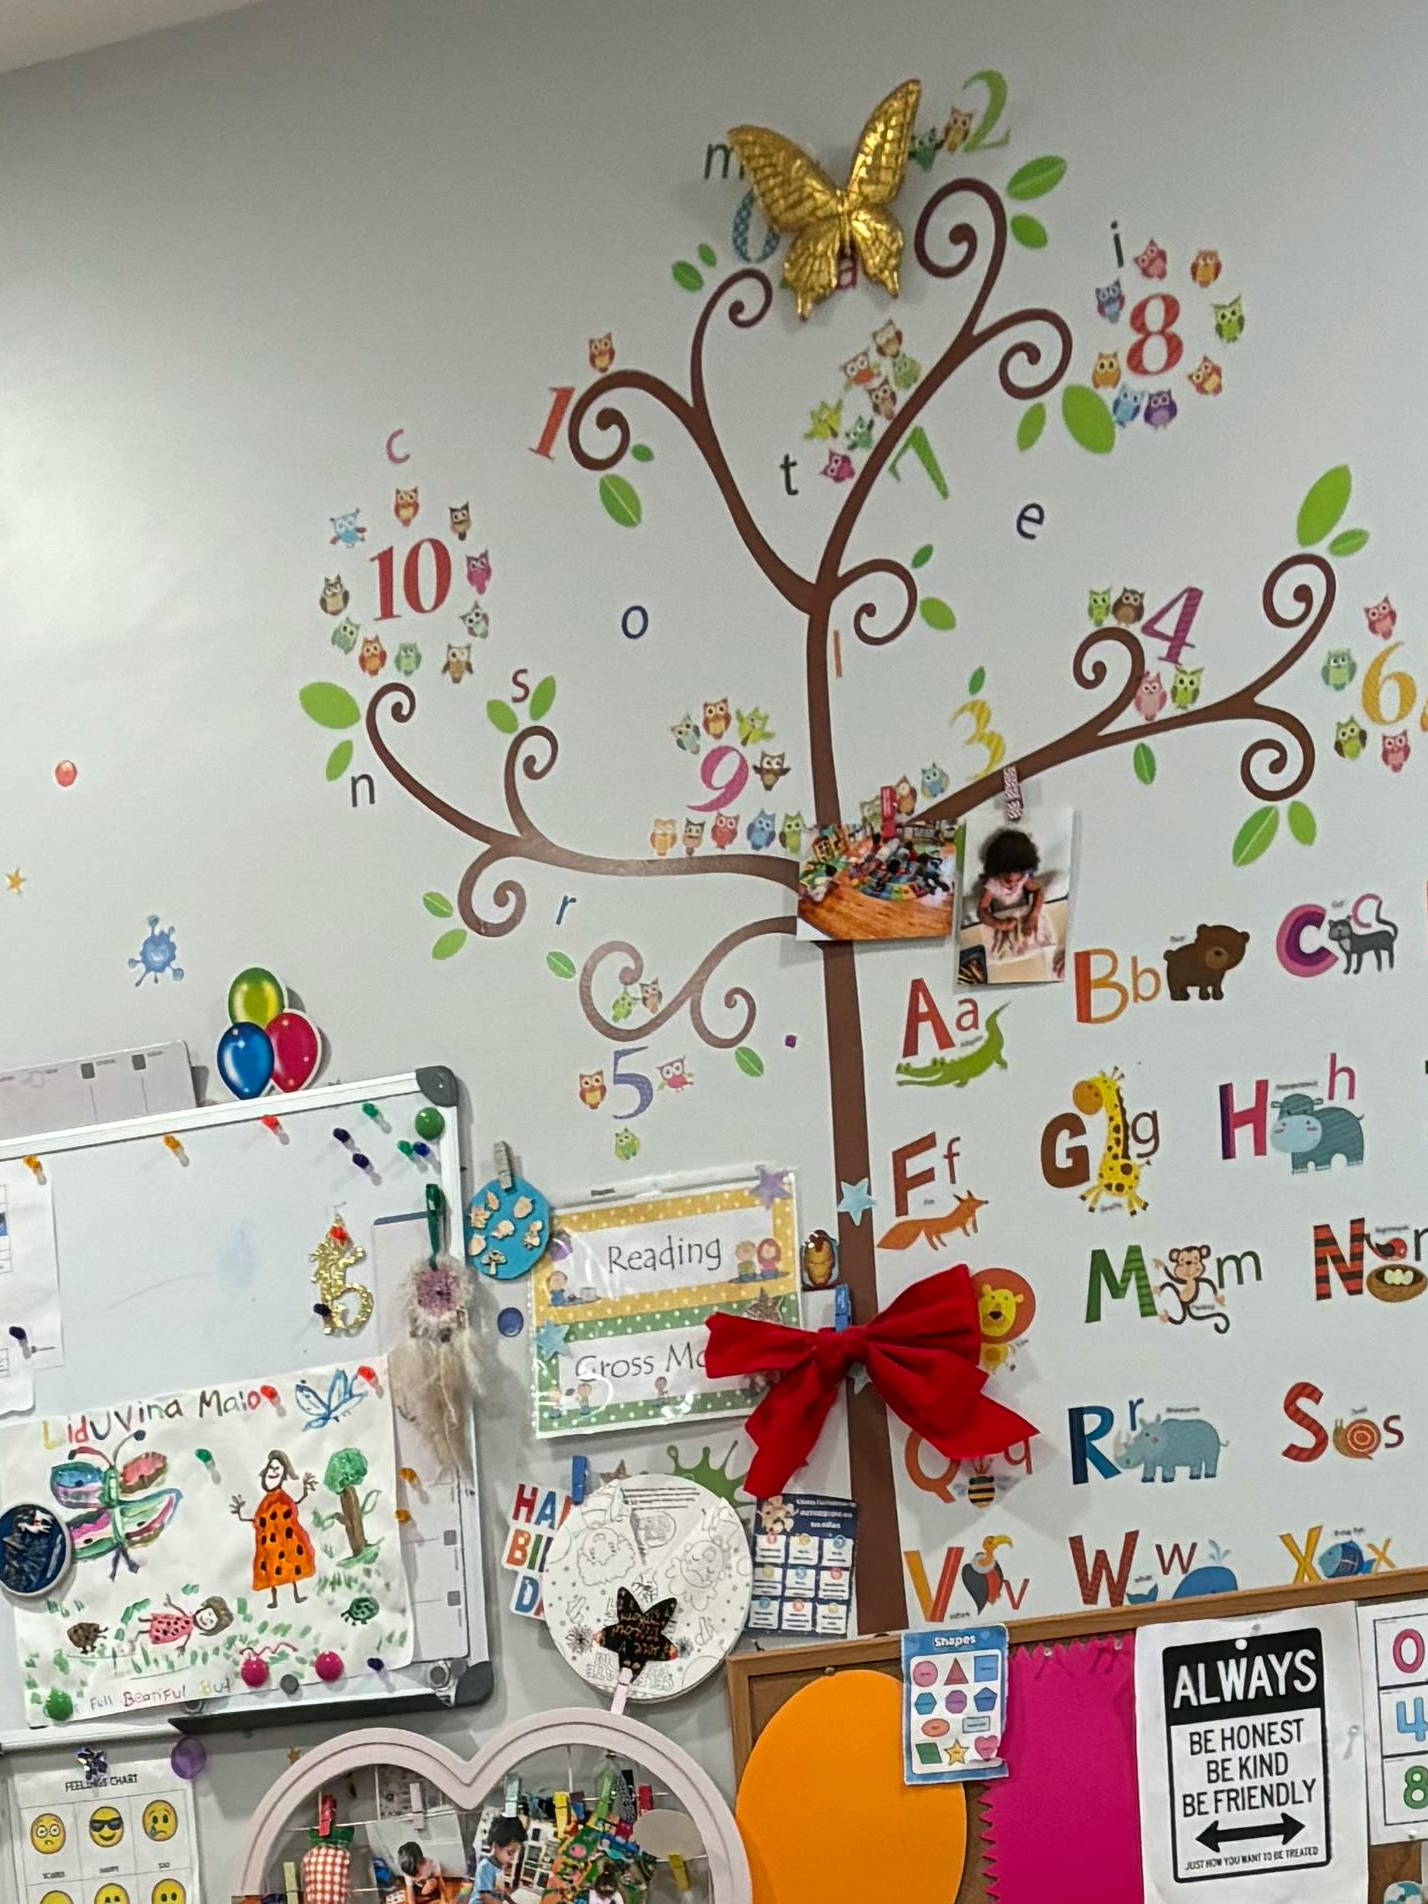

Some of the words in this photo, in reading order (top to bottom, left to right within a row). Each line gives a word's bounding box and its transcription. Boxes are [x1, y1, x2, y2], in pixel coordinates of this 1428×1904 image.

[961, 69, 1011, 153] 2
[1126, 293, 1184, 376] 8
[780, 453, 798, 496] t
[1016, 502, 1045, 541] e
[369, 537, 452, 622] 10
[1140, 585, 1205, 666] 4
[1361, 640, 1417, 726] 6
[687, 745, 749, 813] 9
[612, 1046, 654, 1121] 5
[1219, 1079, 1269, 1160] H
[1040, 1112, 1090, 1189] G
[607, 1236, 722, 1275] Reading
[575, 1351, 655, 1382] Gross
[933, 1635, 976, 1648] Shapes
[1392, 1628, 1425, 1674] 0
[1173, 1648, 1318, 1709] ALWAYS
[1189, 1729, 1217, 1756] BE
[1221, 1718, 1304, 1752] HONEST
[1396, 1696, 1428, 1742] 4
[65, 1778, 108, 1792] FEELINGS
[109, 1773, 138, 1786] CHART
[1206, 1757, 1234, 1784] BE
[1239, 1751, 1289, 1780] KIND
[1182, 1791, 1209, 1818] BE
[1214, 1778, 1316, 1814] FRIENDLY
[1185, 1858, 1205, 1871] JUST
[1206, 1857, 1222, 1869] HOW
[1223, 1856, 1241, 1867] YOU
[1241, 1853, 1263, 1865] WANT
[1263, 1851, 1273, 1863] TO
[1273, 1849, 1284, 1861] BE
[1285, 1846, 1319, 1860] TREATED
